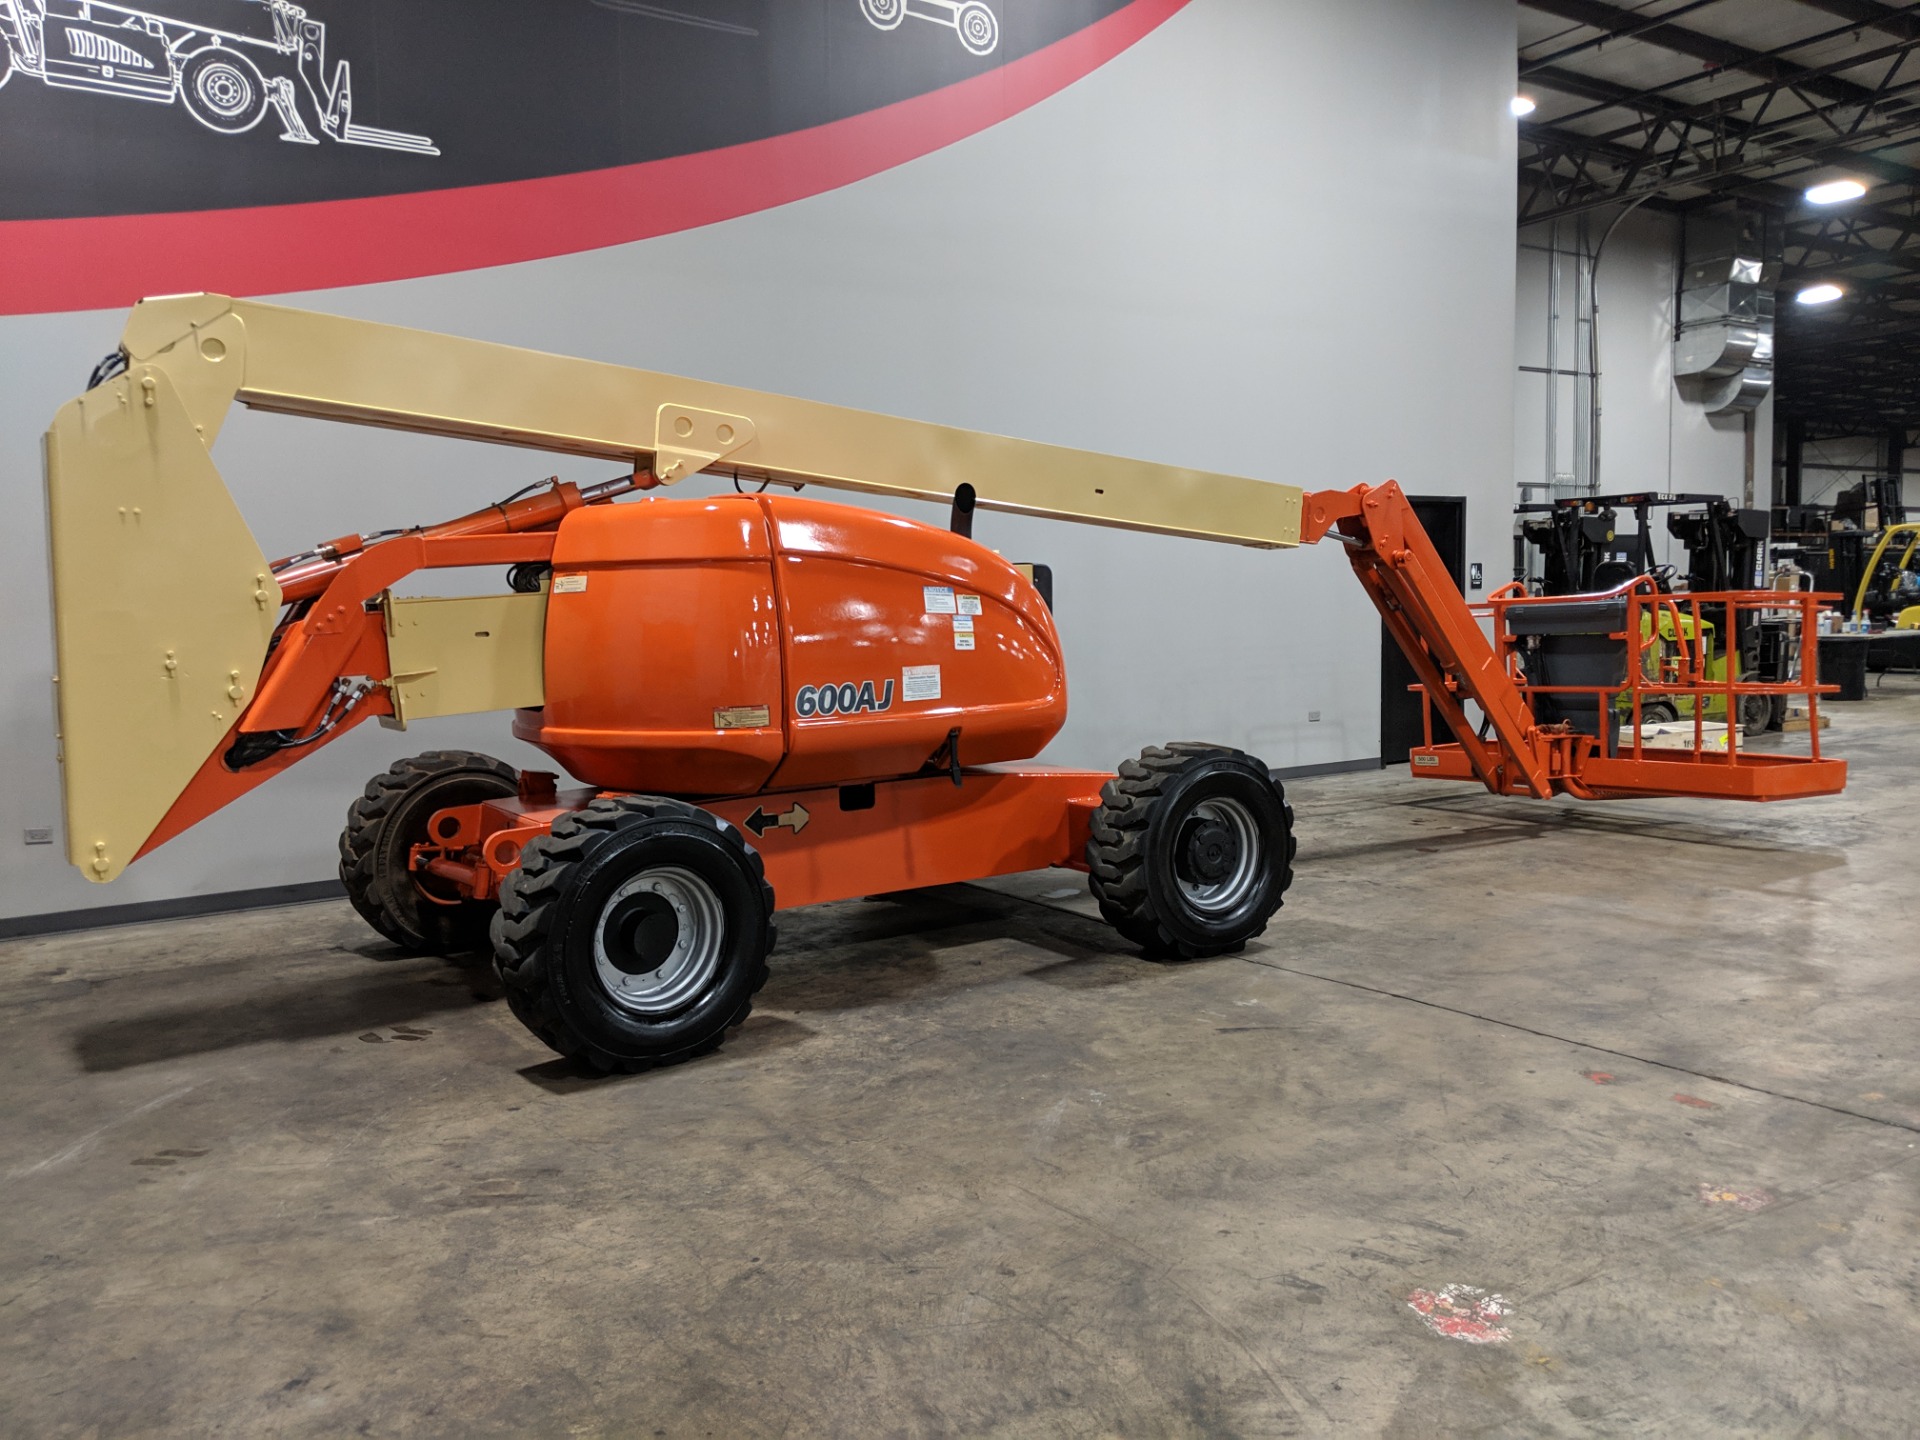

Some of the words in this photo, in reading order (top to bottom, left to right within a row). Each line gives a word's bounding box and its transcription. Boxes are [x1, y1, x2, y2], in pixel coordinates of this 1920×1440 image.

[1756, 540, 1764, 571] CLARK
[1667, 627, 1689, 637] CLK
[795, 678, 895, 717] 600AJ
